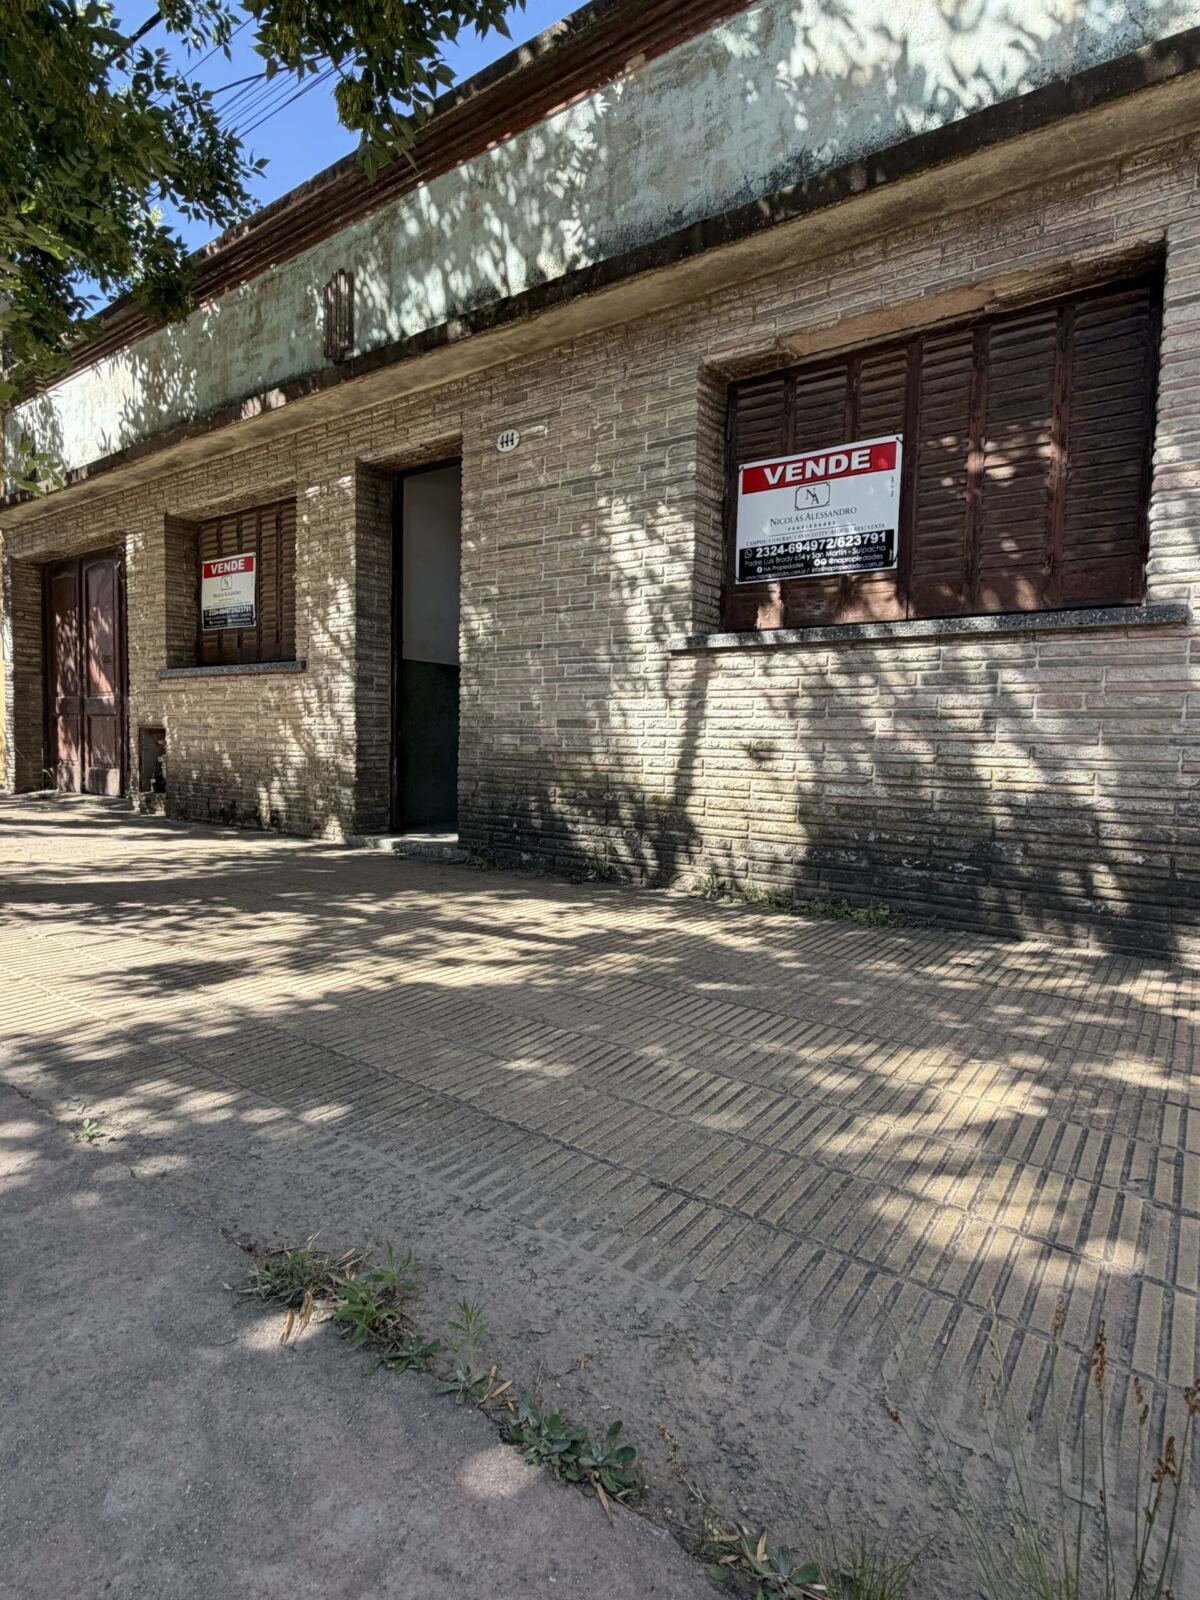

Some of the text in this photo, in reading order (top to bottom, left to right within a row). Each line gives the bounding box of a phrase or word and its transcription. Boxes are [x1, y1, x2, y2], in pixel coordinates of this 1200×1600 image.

[500, 432, 514, 448] 444
[764, 449, 871, 485] VENDE
[806, 506, 857, 521] ALESSANDRO
[756, 532, 886, 558] 2324-694972/623791
[745, 559, 762, 567] Padre
[776, 556, 793, 564] Brady
[852, 544, 886, 556] Suipacha
[211, 559, 245, 574] VENDE
[772, 563, 804, 572] Propiedades
